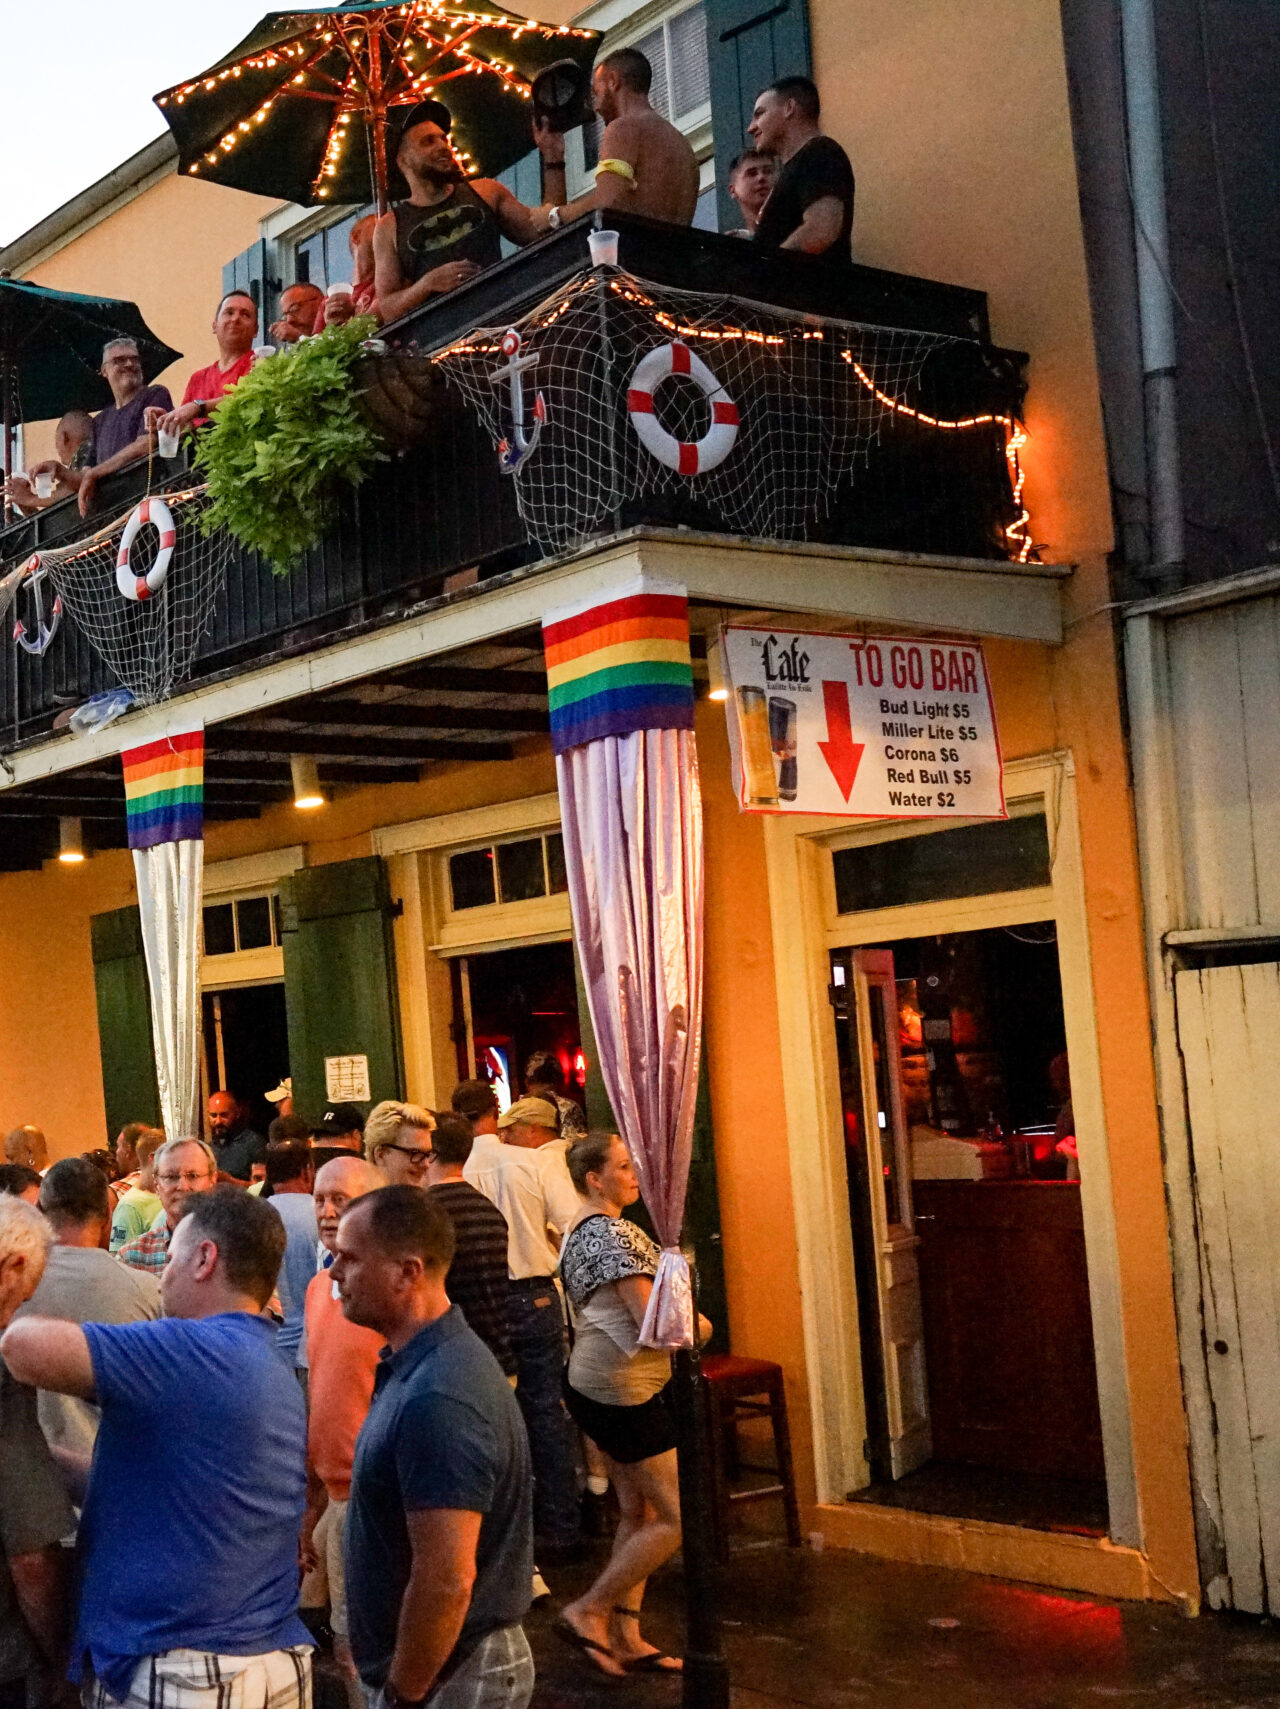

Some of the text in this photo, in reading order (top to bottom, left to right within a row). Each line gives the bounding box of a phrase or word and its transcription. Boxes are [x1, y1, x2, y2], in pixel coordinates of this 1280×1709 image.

[751, 637, 762, 647] The
[849, 643, 978, 693] TO GO BAR
[880, 699, 970, 720] Bud Light $5
[882, 722, 977, 741] Miller Lite $5
[885, 745, 959, 764] Corona $6
[887, 768, 971, 786] Red Bull $5
[889, 791, 955, 807] Water $2
